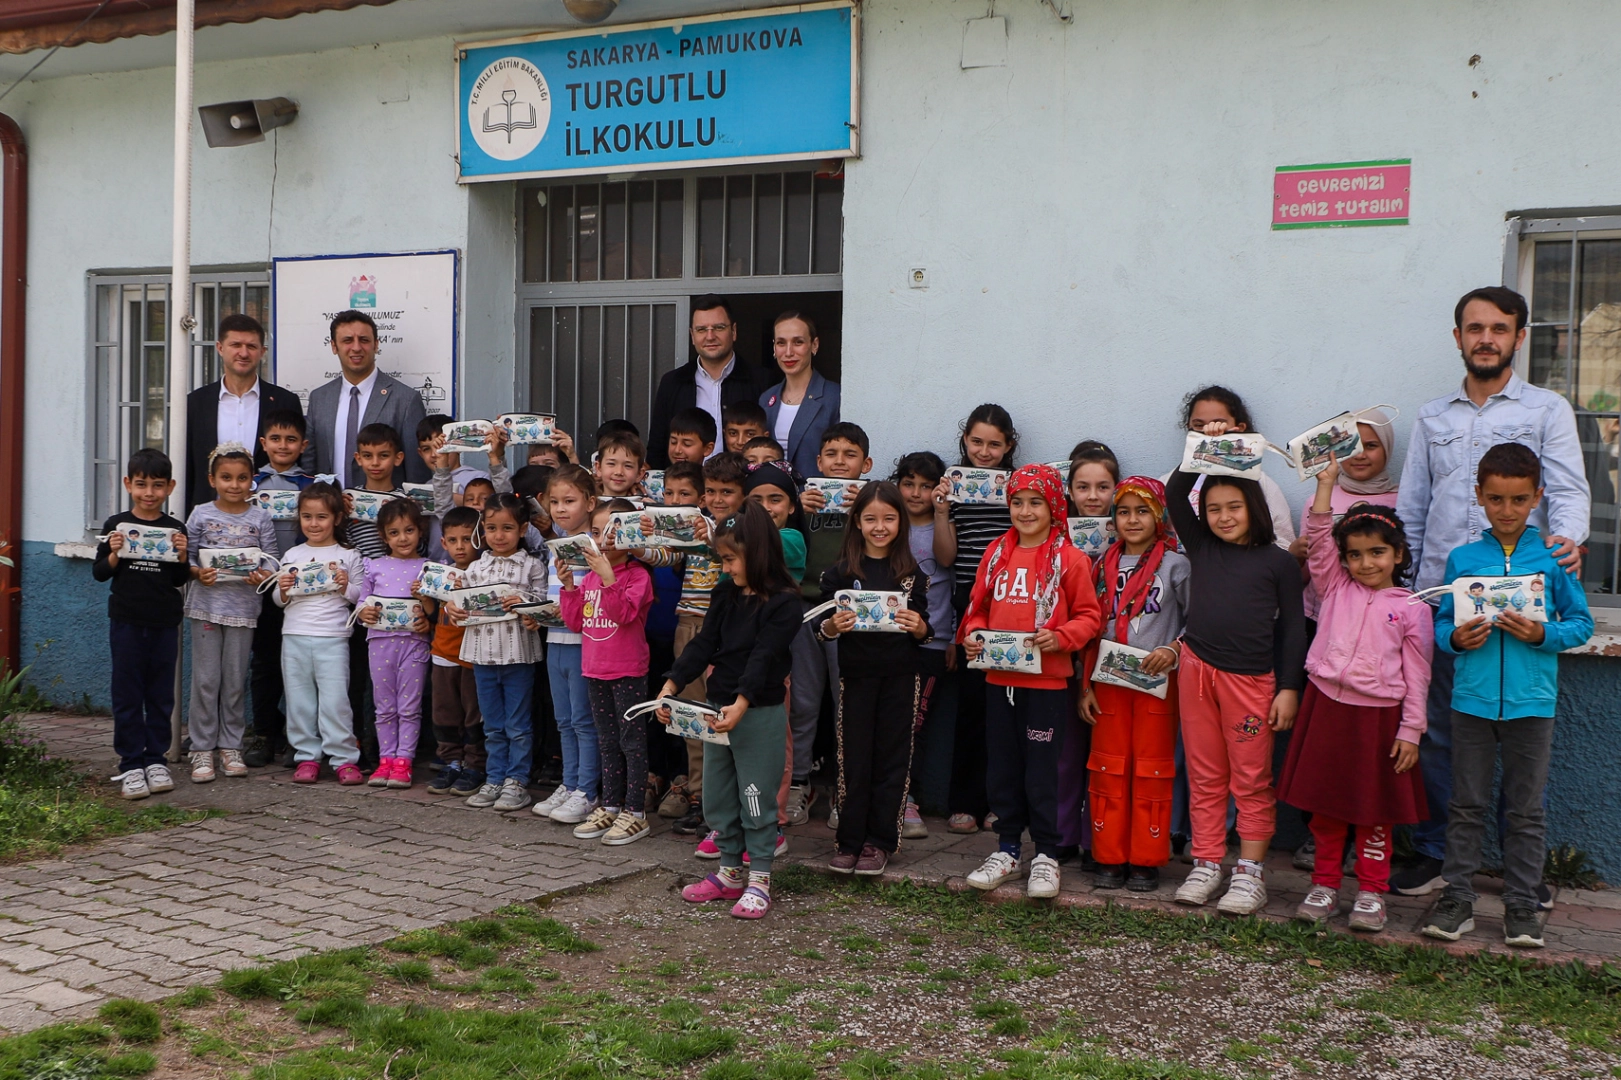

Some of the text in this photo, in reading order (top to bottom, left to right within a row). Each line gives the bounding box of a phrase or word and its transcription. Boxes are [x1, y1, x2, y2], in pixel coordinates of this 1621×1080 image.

[566, 42, 659, 70] SAKARYA
[679, 26, 803, 58] PAMUKOVA
[494, 59, 519, 72] EĞİTİM
[521, 63, 548, 102] BAKANLIĞI
[565, 69, 727, 112] TURGUTLU
[565, 117, 717, 156] İLKOKULU
